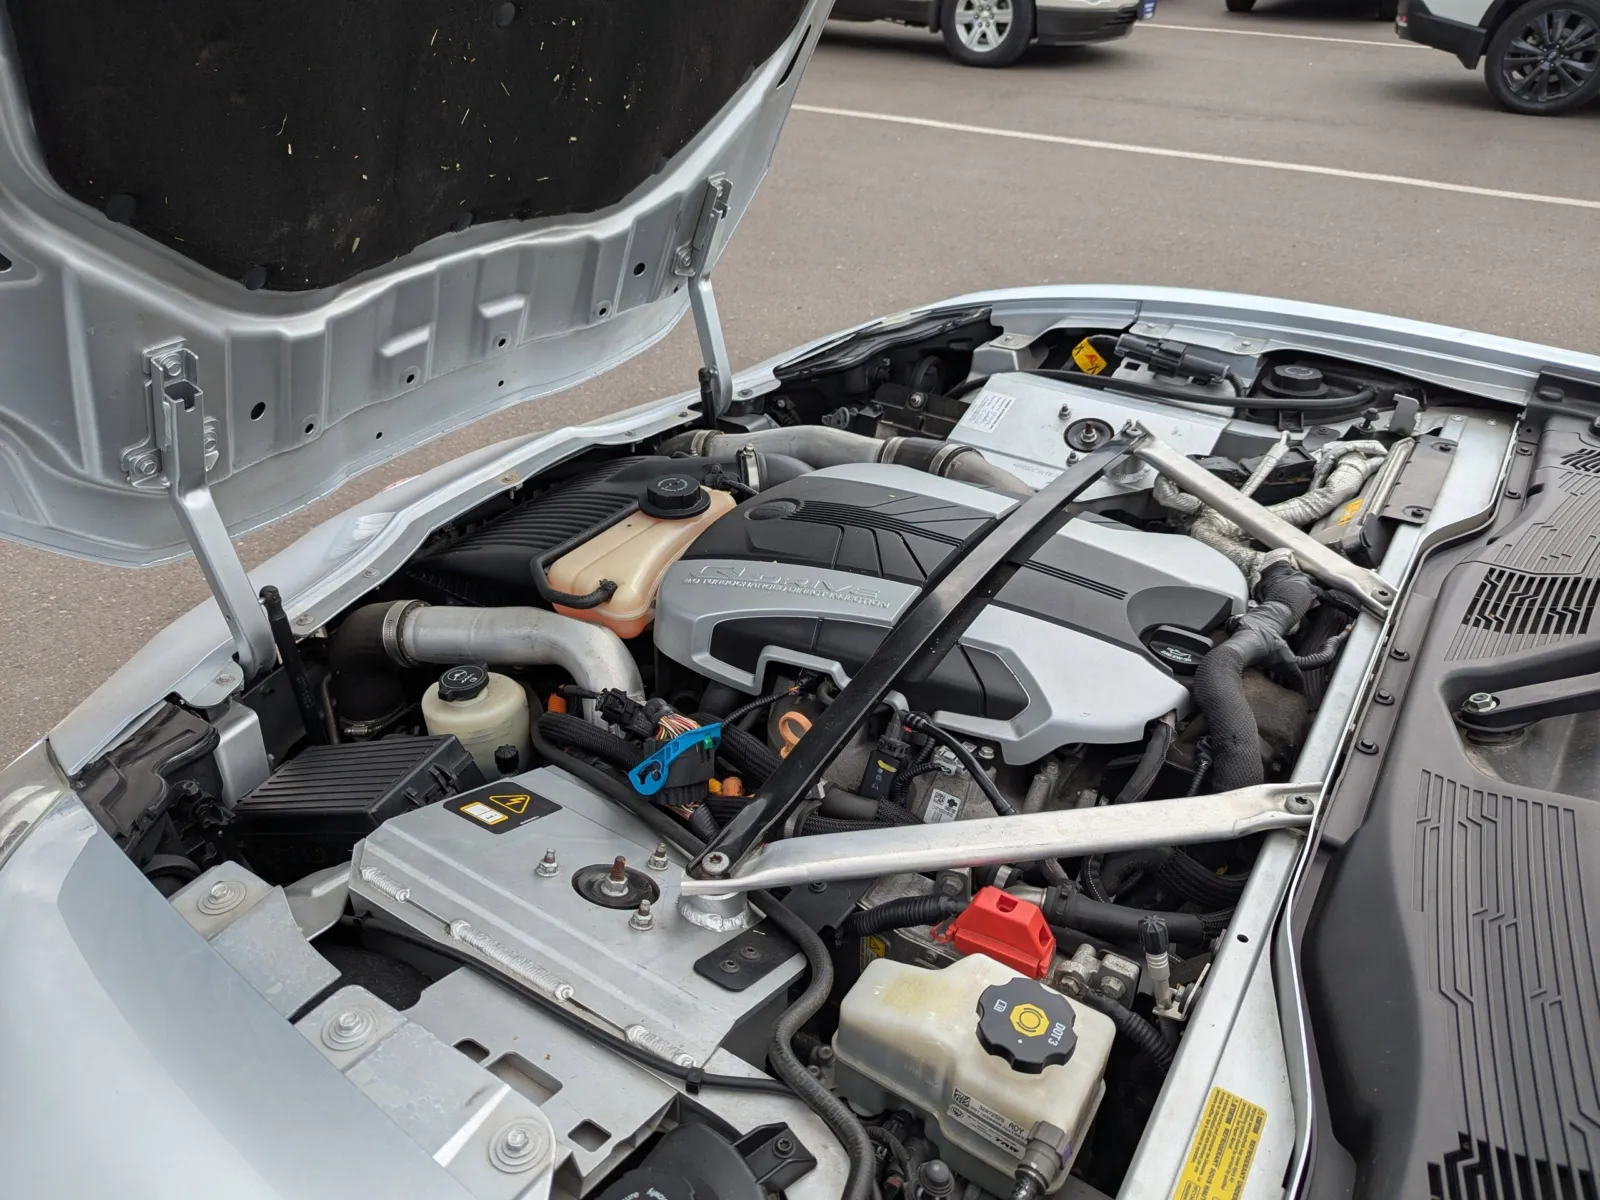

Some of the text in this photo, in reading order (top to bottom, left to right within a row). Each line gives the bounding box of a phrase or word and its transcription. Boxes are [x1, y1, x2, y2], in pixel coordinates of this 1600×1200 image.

[1047, 1022, 1066, 1046] DOT 3
[1240, 1139, 1256, 1179] REFRIGERANT
